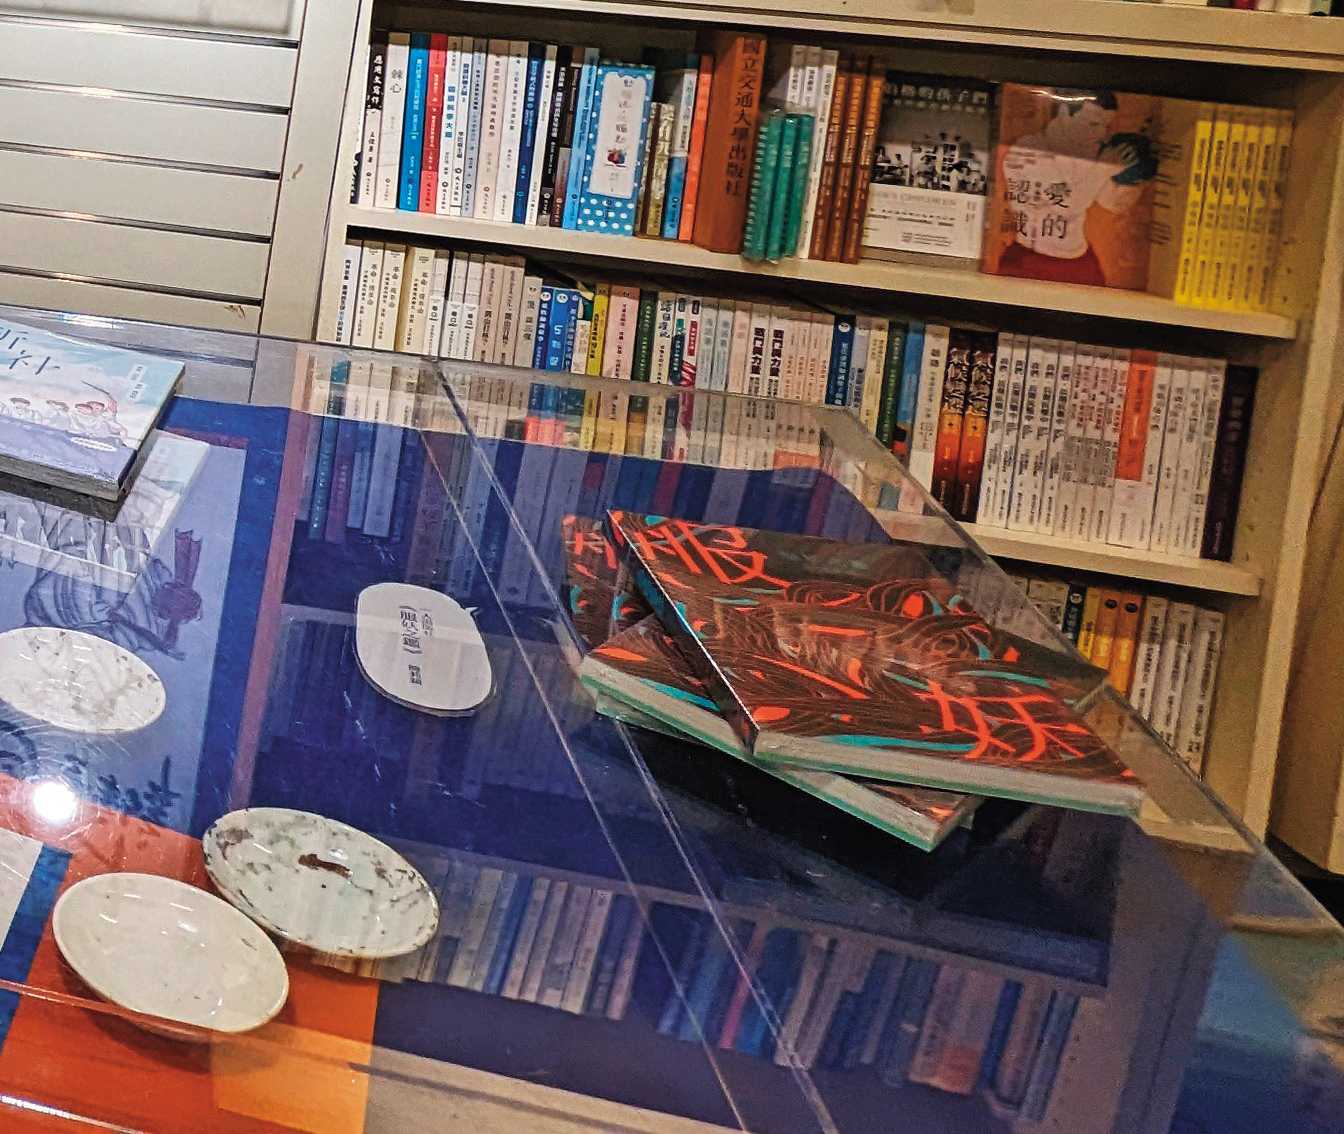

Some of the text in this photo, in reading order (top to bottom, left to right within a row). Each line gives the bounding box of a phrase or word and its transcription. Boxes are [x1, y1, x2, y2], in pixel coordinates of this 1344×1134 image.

[724, 40, 762, 197] 國立交通大學出版社
